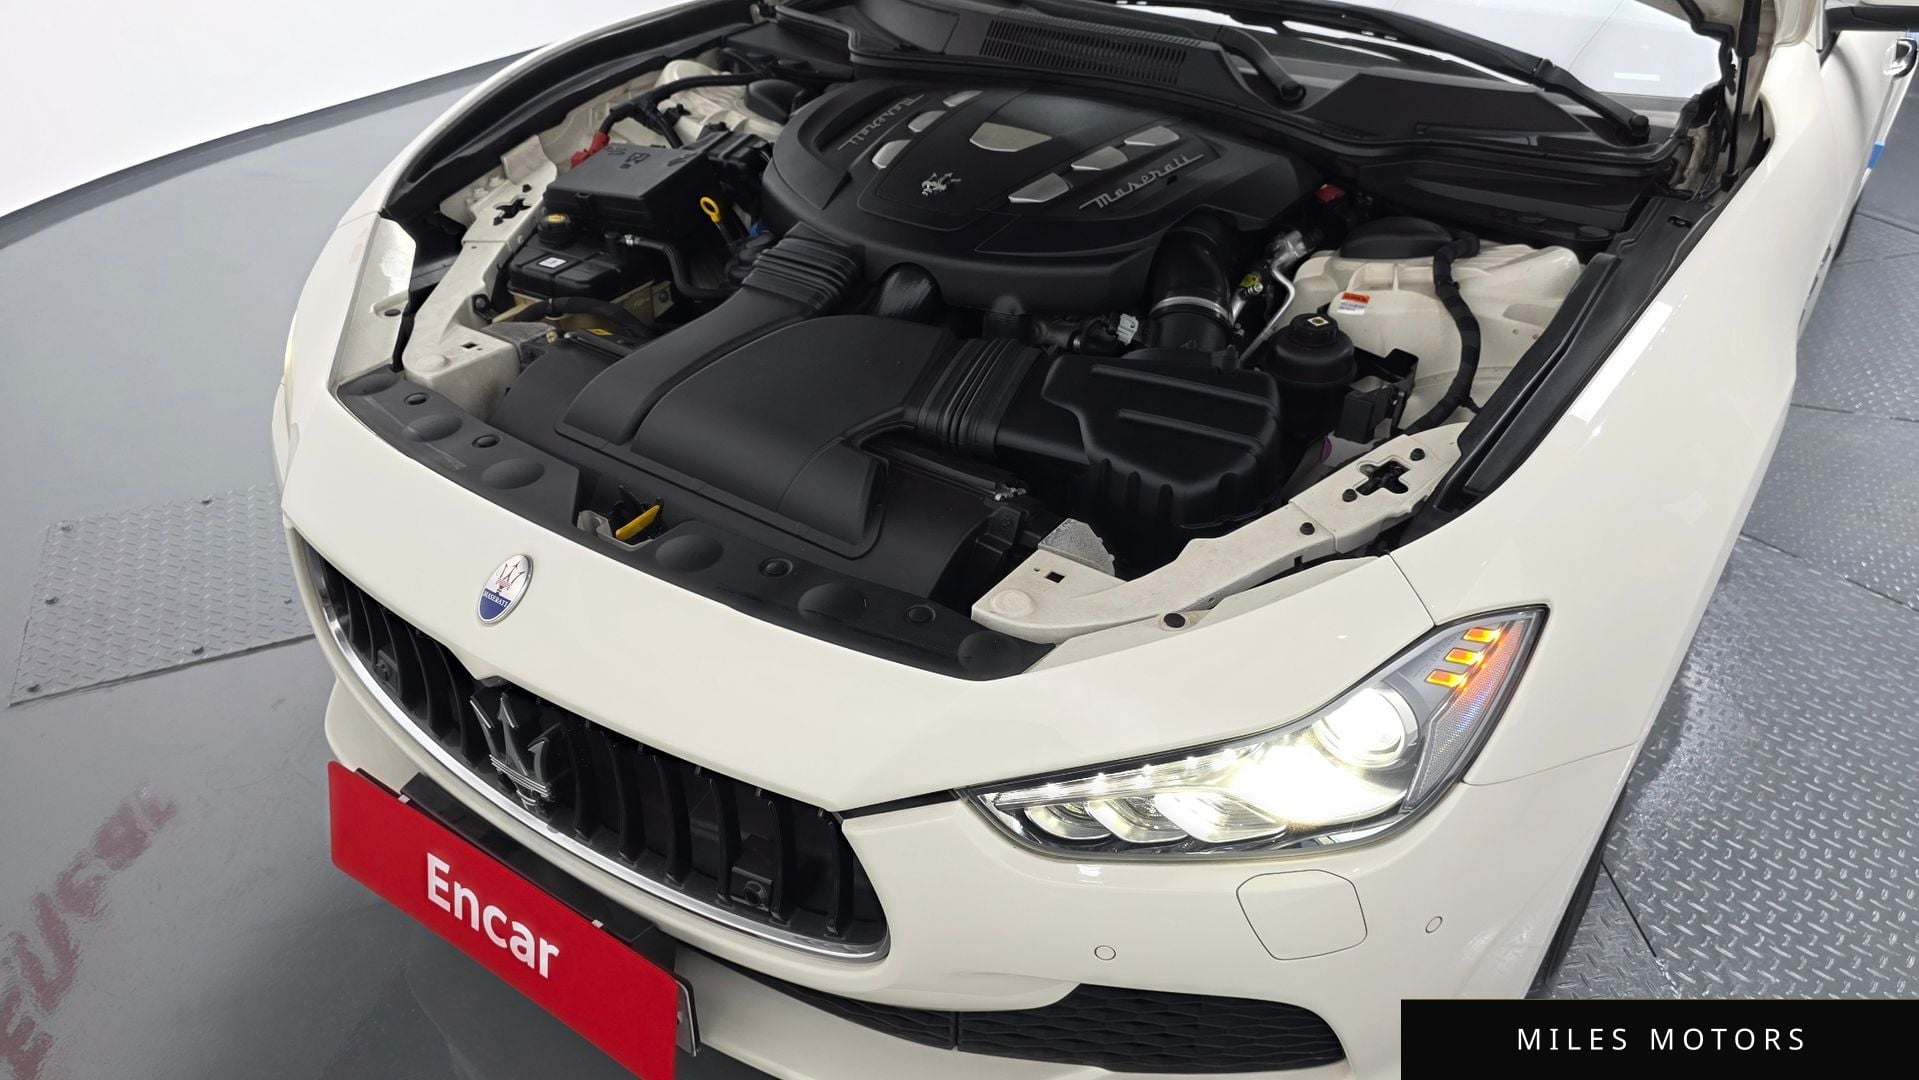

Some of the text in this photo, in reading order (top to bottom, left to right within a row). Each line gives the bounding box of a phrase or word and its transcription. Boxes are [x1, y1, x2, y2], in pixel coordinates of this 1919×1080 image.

[838, 94, 924, 151] Maserati
[1079, 153, 1204, 210] Maserati
[484, 591, 509, 608] MASERATI
[428, 853, 559, 978] Encar
